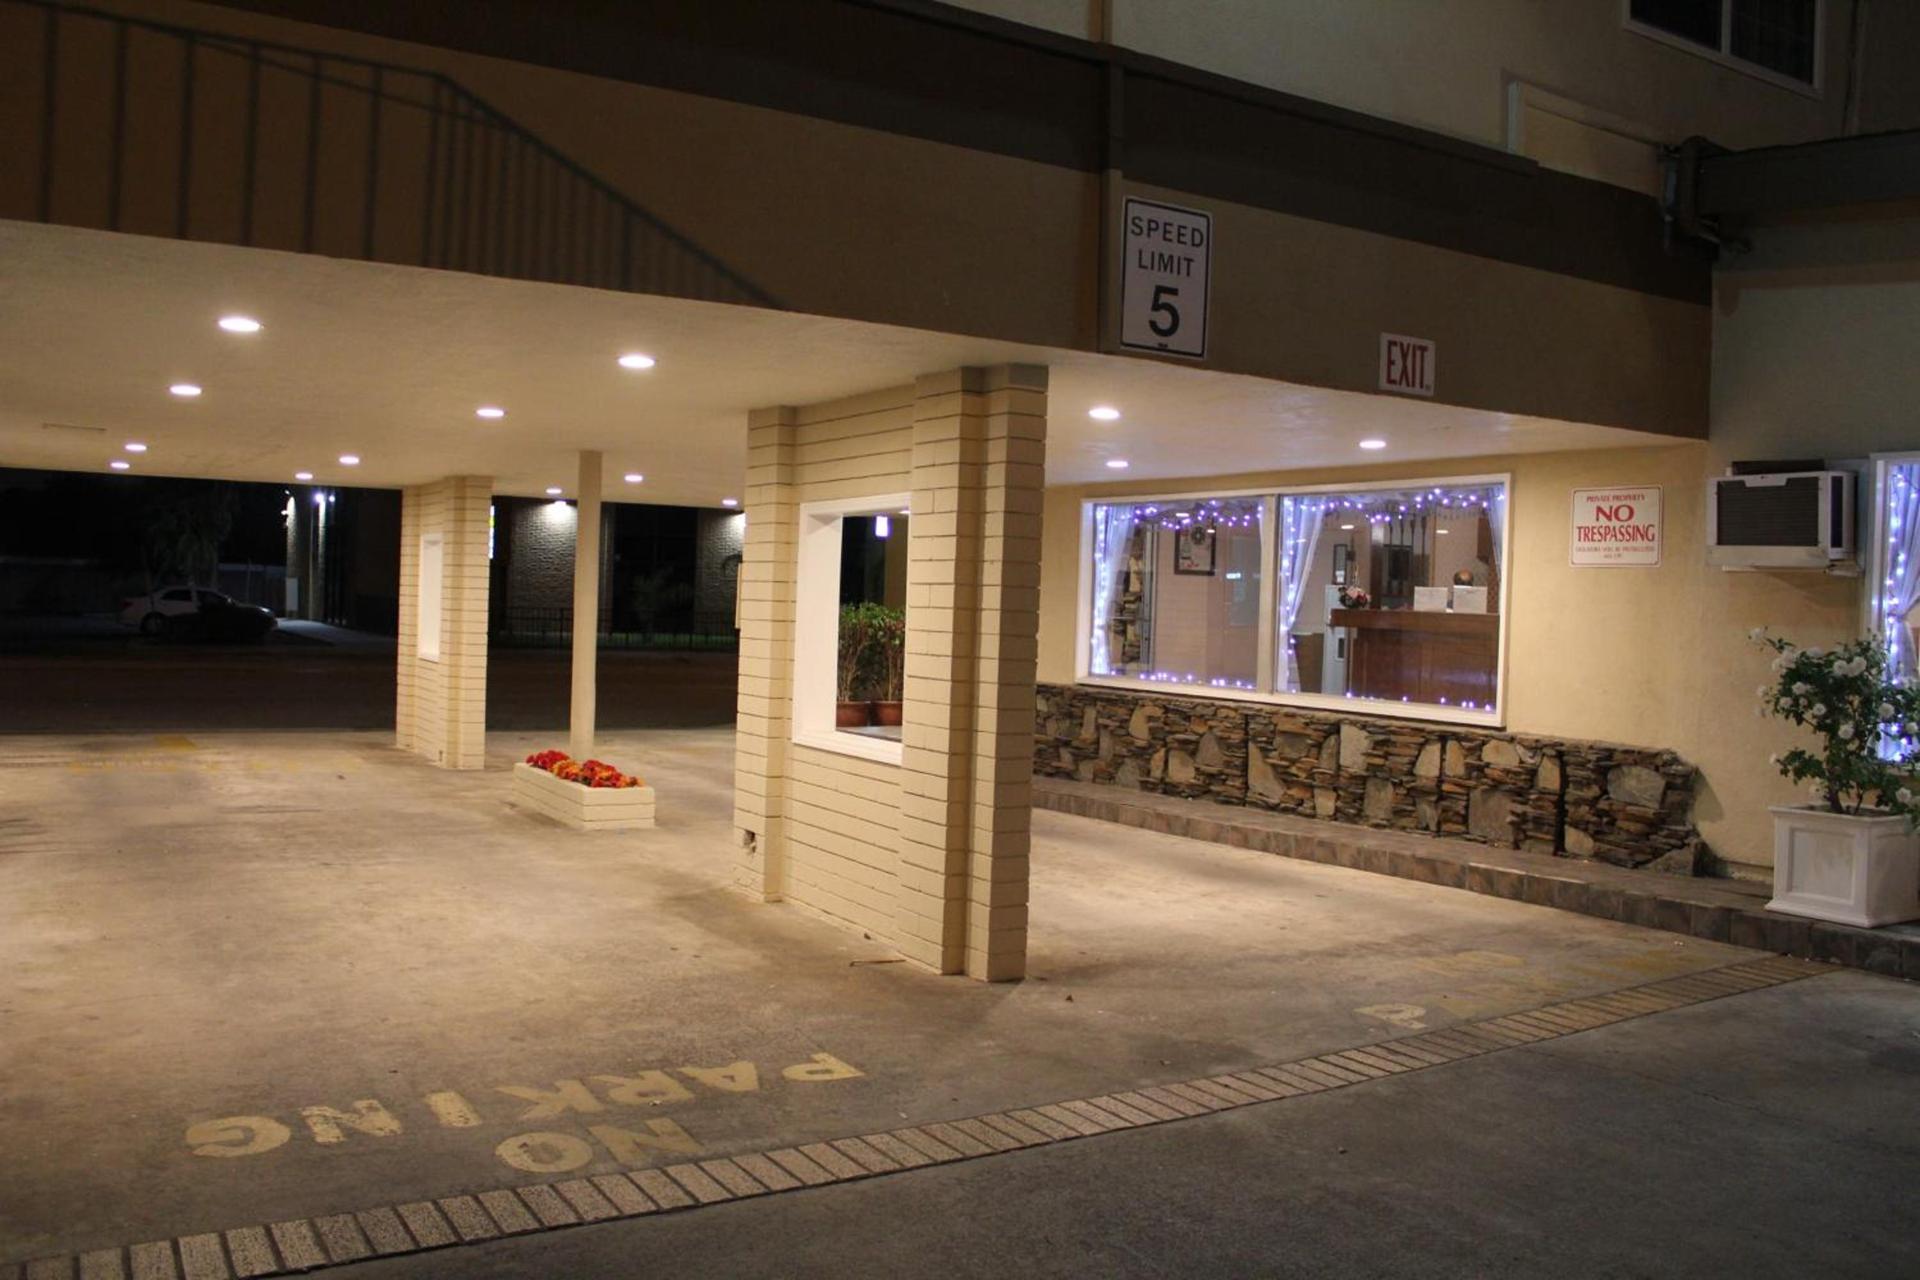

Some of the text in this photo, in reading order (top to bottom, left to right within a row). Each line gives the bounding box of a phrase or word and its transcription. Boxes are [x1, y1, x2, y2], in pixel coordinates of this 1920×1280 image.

[1130, 216, 1204, 248] SPEED
[1138, 248, 1195, 277] LIMIT
[1148, 284, 1180, 337] 5
[1386, 340, 1429, 389] EXIT
[1576, 524, 1656, 542] TRESPASSING
[1595, 504, 1635, 522] NO
[185, 1051, 867, 1159] PARKING
[495, 1116, 703, 1173] NO
